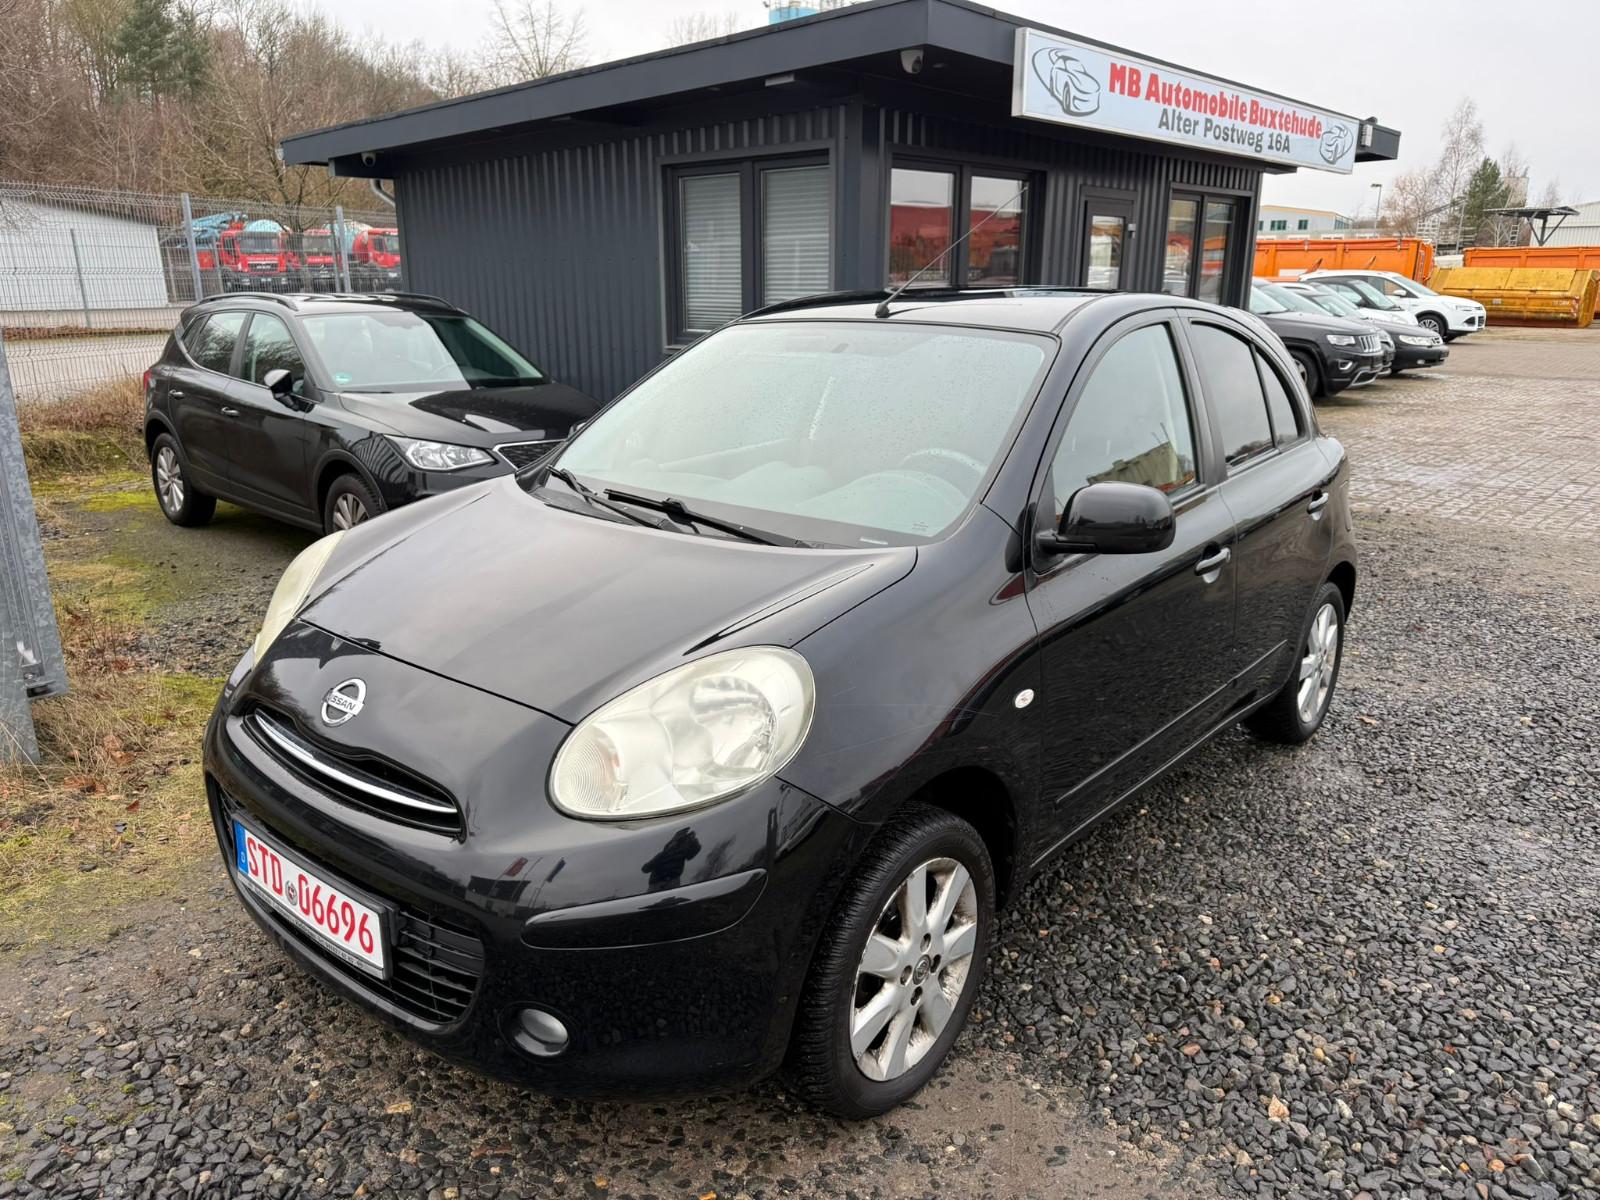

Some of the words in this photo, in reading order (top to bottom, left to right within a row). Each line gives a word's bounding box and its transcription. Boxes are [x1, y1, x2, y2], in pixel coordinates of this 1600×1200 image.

[1109, 62, 1141, 98] MB
[1145, 73, 1247, 122] Automobile
[1249, 99, 1322, 139] Buxtehude
[1158, 108, 1199, 136] Alter
[1203, 118, 1264, 153] Postweg
[1268, 132, 1290, 153] 16A
[247, 837, 283, 896] STD
[298, 873, 373, 954] 06696
